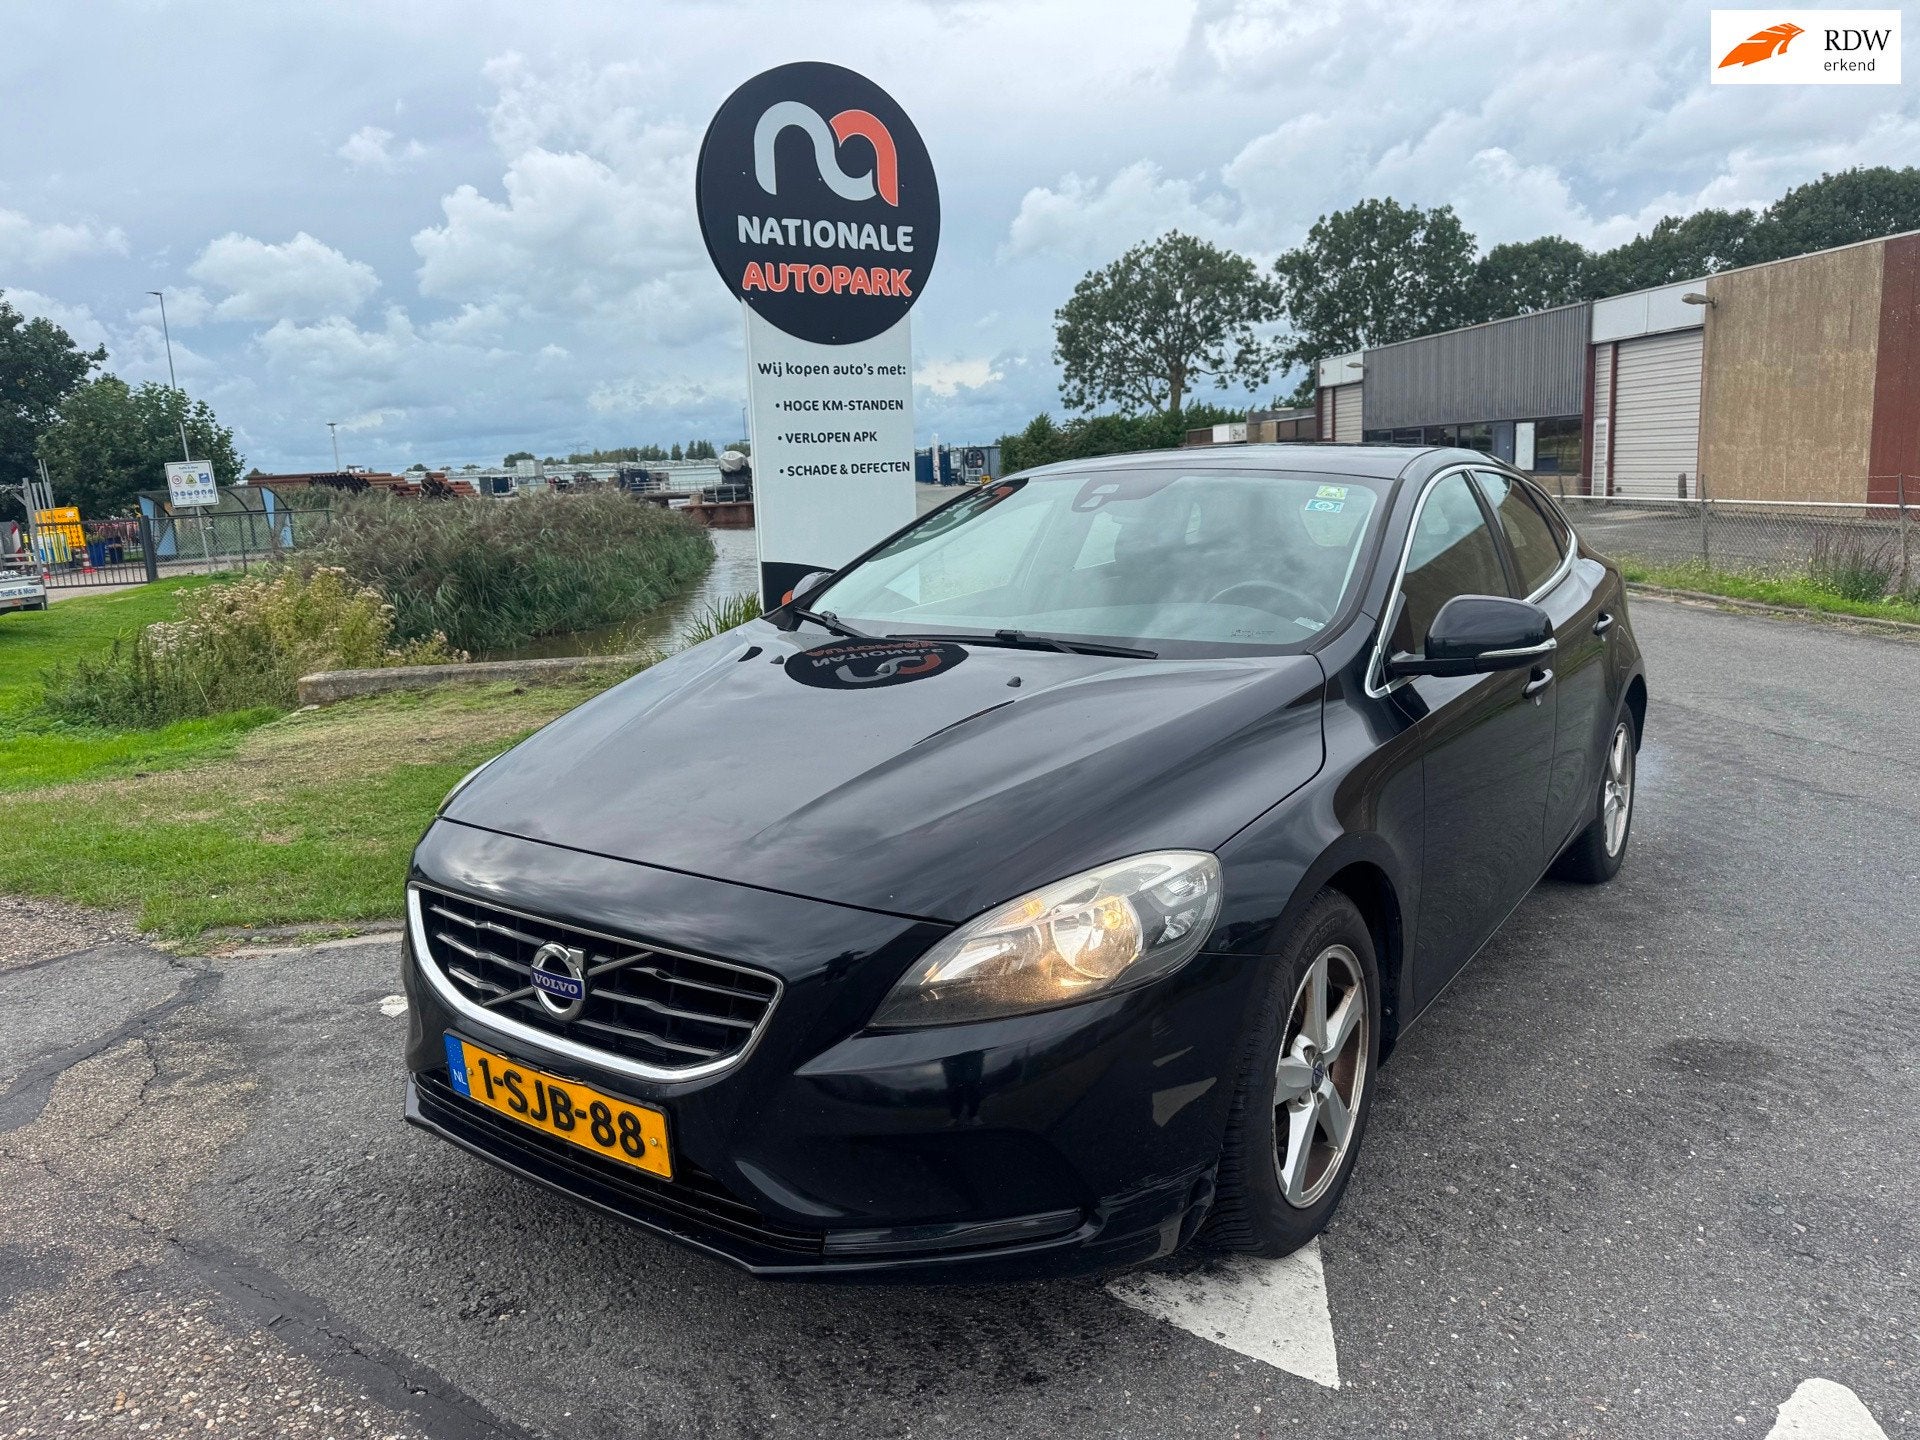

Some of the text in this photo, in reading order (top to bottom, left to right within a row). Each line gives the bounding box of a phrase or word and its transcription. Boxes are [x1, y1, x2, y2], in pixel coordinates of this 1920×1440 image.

[737, 215, 914, 253] NATIONALE
[742, 261, 913, 298] AUTOPARK
[757, 361, 907, 378] Wij kopen auto's met:
[783, 399, 904, 412] HOGE KM-STANDEN
[785, 431, 878, 444] VERLOPEN APK
[787, 461, 911, 477] SCHADE & DEFECTEN
[533, 972, 579, 994] VOLVO
[452, 1068, 467, 1085] NL
[478, 1057, 646, 1159] 1-SJB-88
